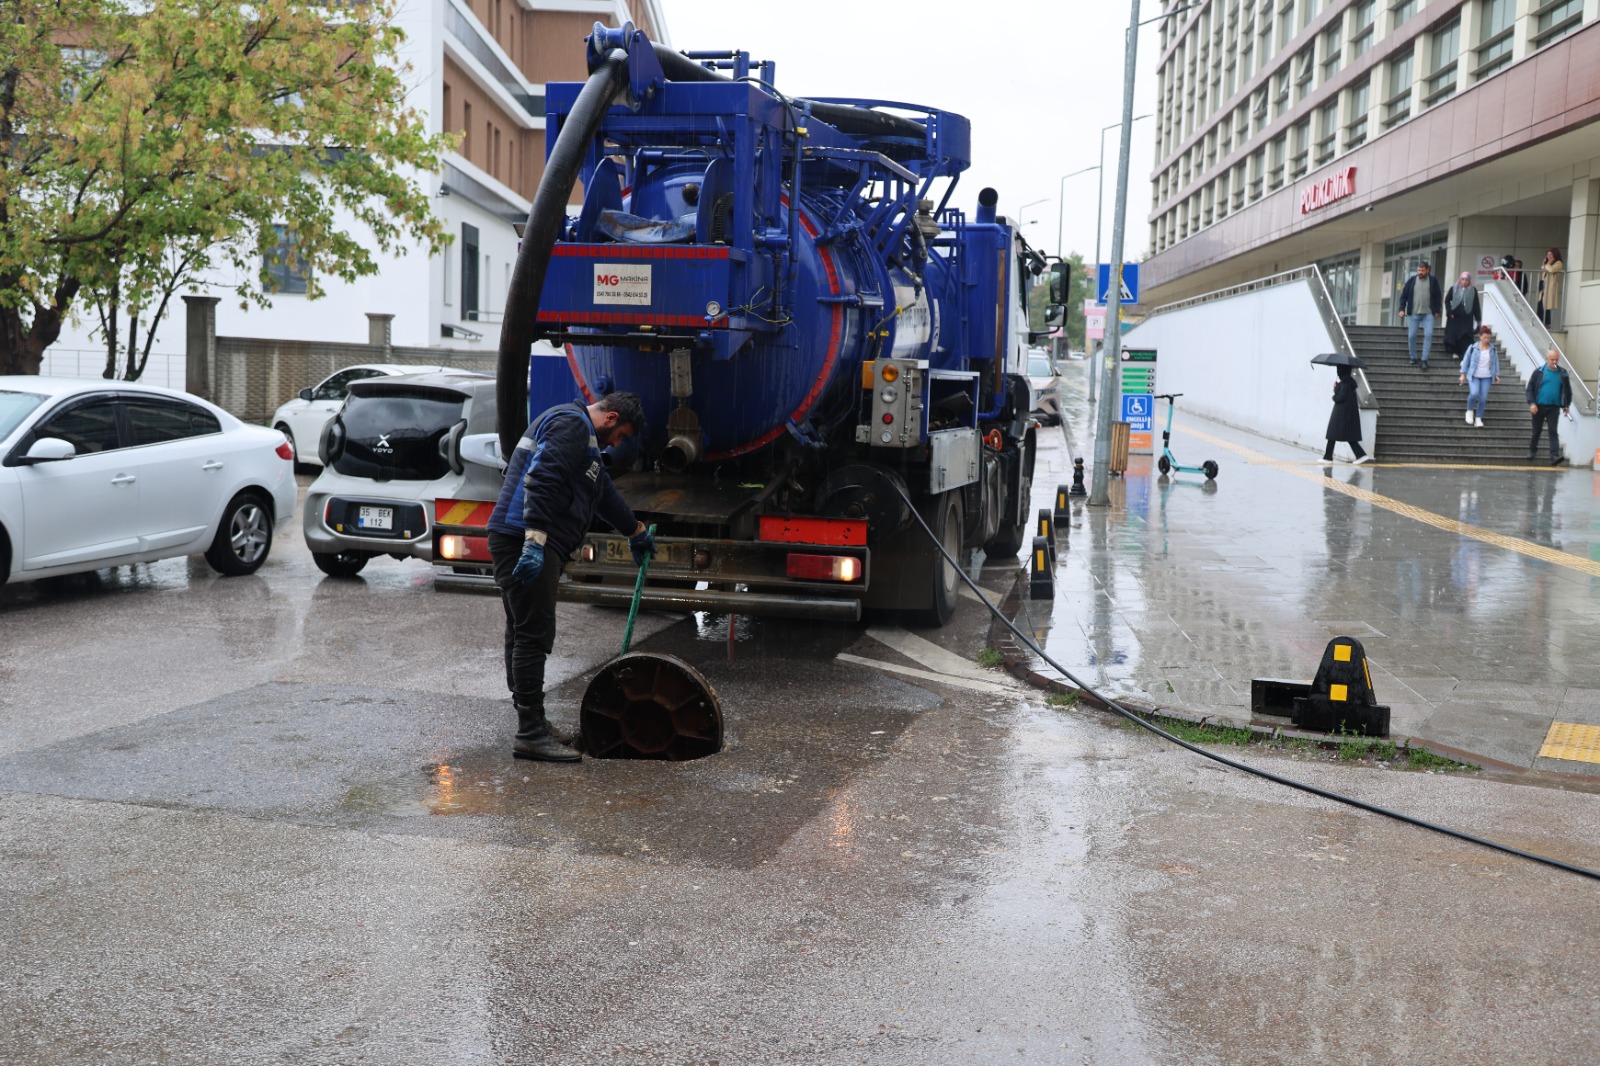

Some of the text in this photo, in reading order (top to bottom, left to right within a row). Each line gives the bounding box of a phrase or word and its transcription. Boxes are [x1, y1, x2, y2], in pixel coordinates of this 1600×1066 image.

[597, 275, 619, 286] MG
[361, 508, 392, 518] 35 BEK
[370, 518, 383, 527] 112
[607, 543, 624, 558] 34
